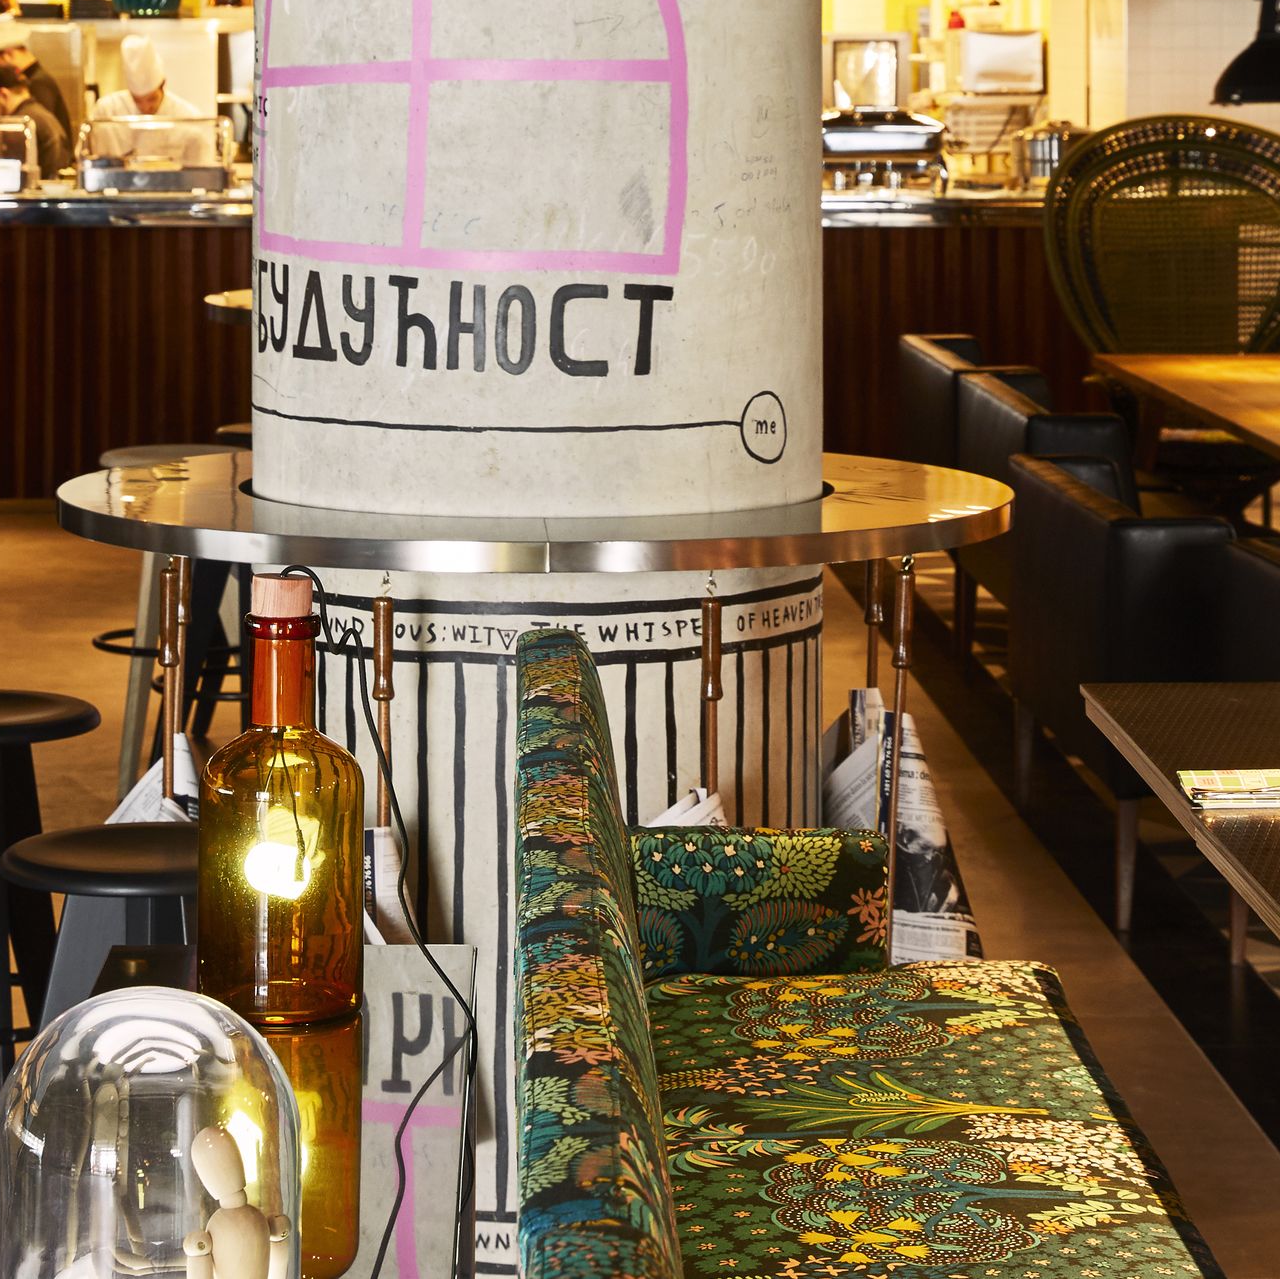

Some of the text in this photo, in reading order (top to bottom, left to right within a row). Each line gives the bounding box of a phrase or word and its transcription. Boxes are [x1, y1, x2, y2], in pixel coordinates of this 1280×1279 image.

[256, 258, 675, 377] БУДУЋНОСТ
[754, 417, 777, 435] me
[598, 617, 703, 643] WHISPE
[736, 612, 757, 632] OF
[762, 601, 813, 628] HEAVEN
